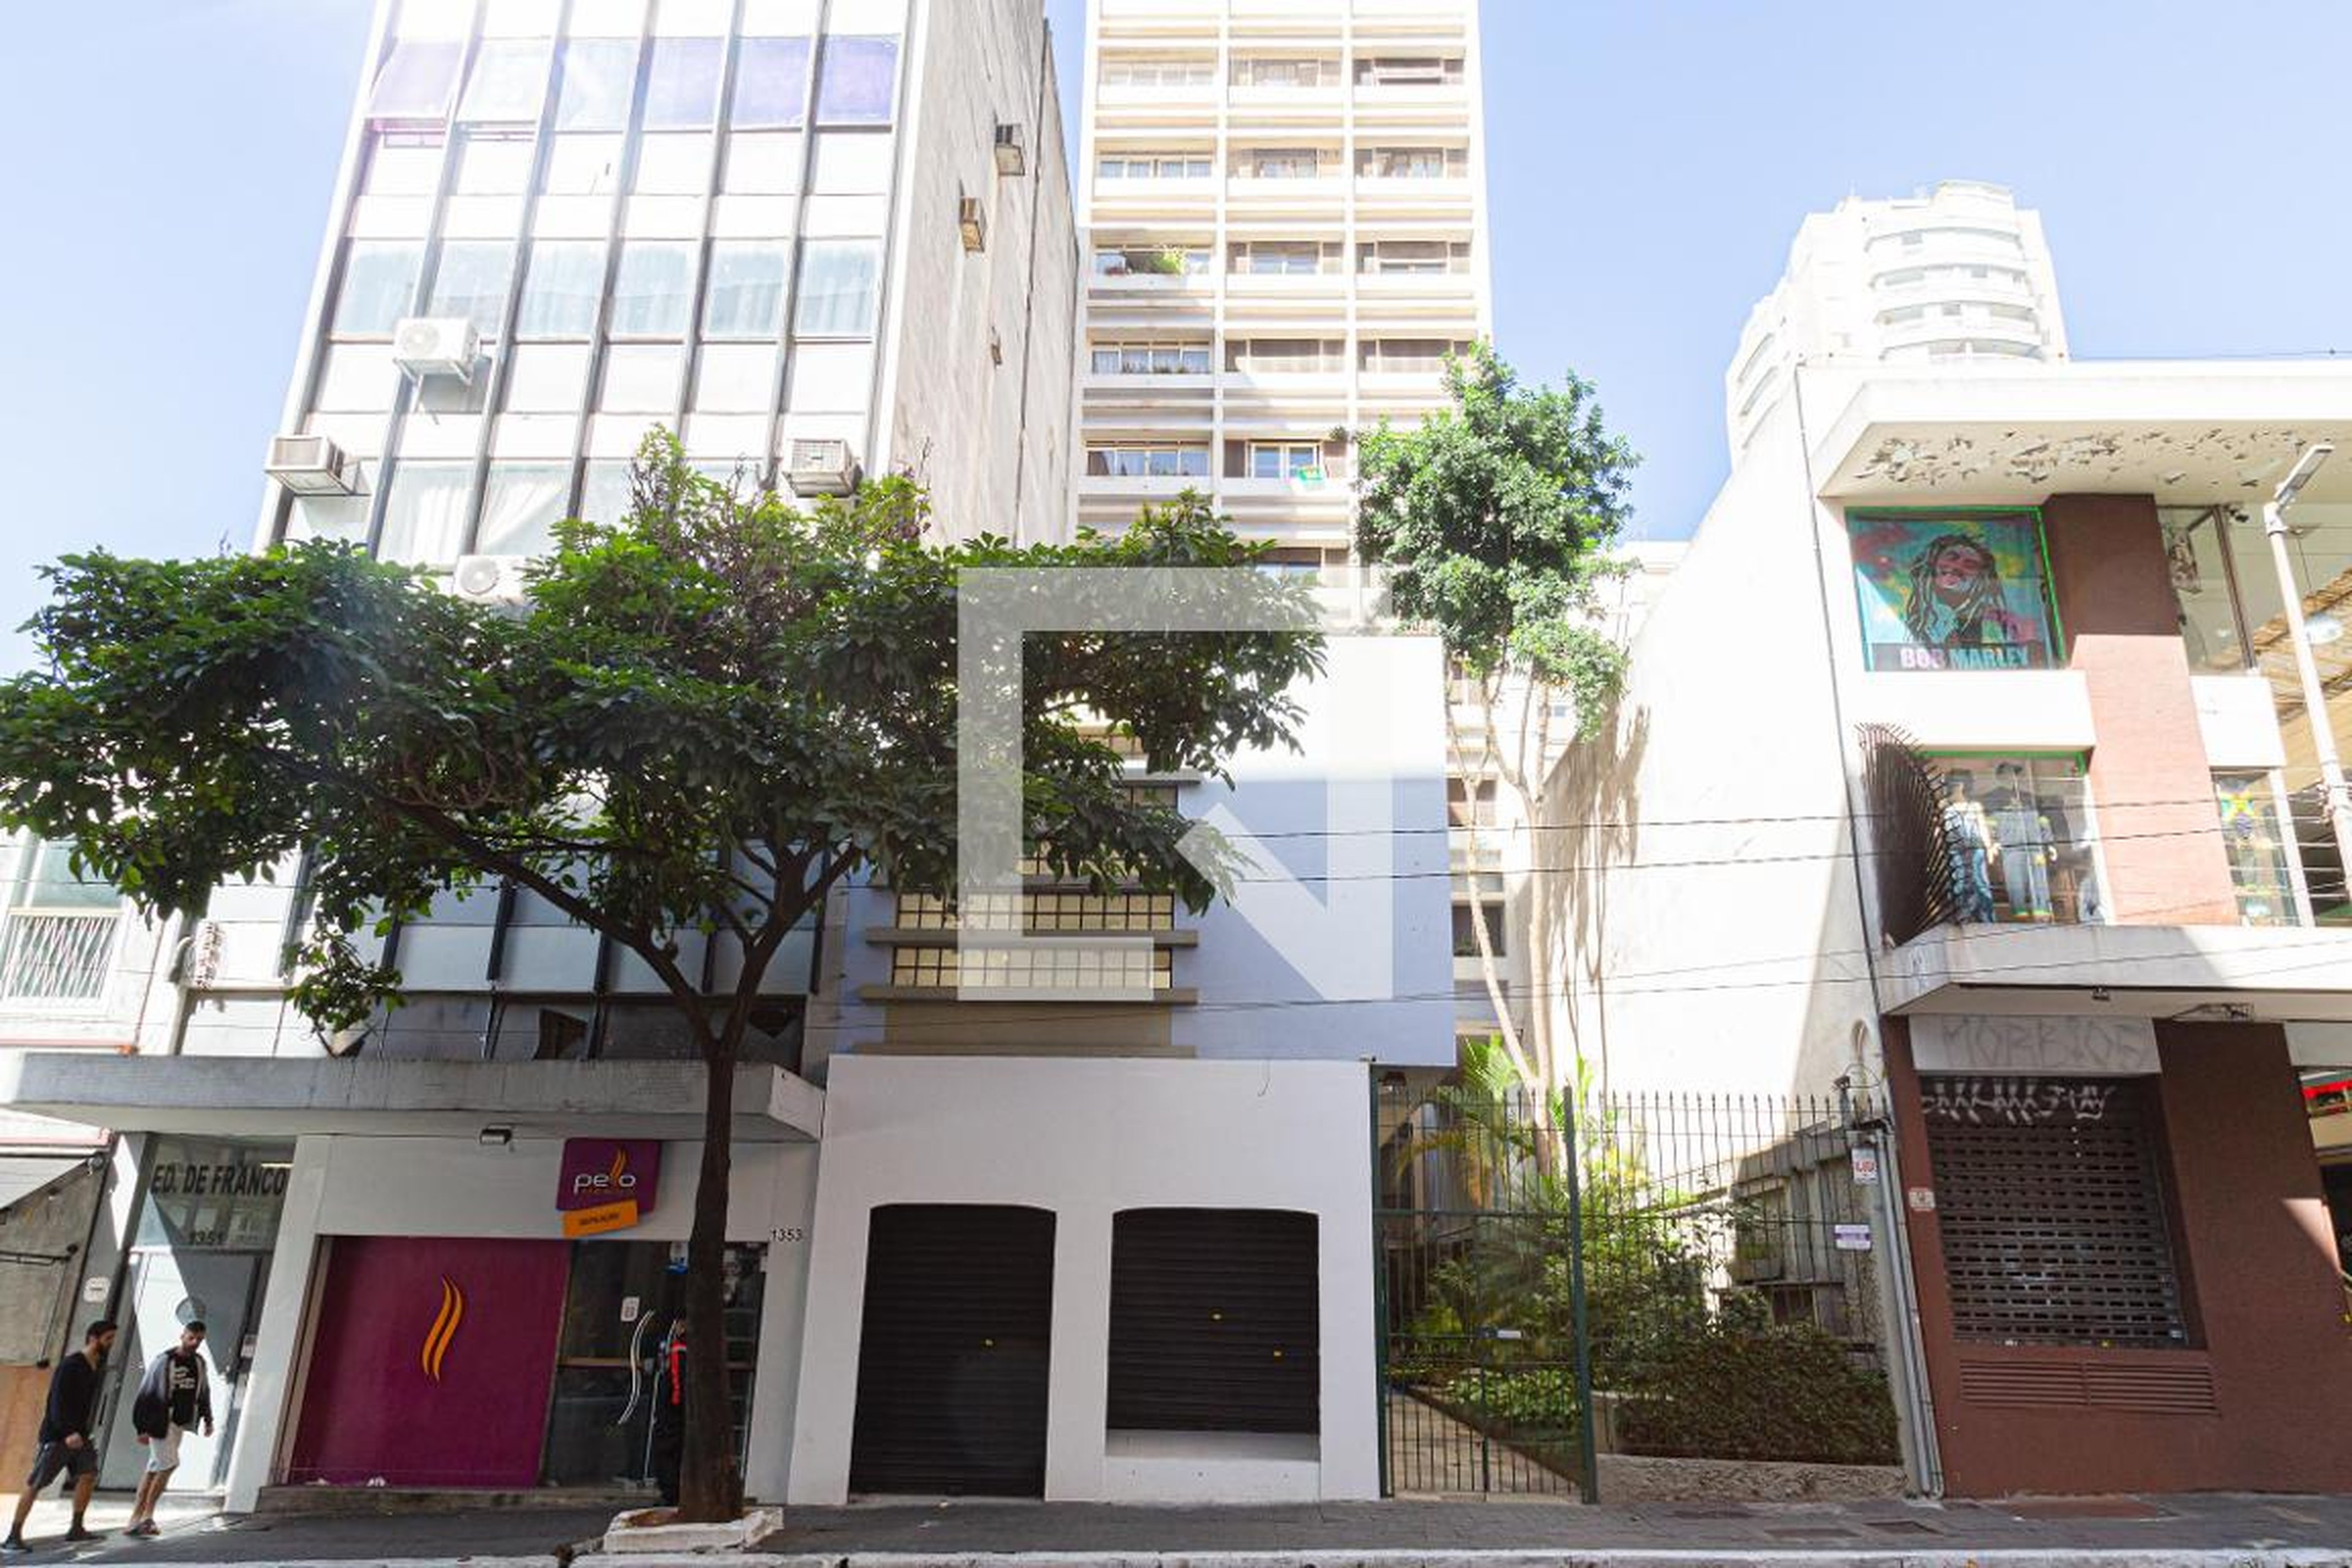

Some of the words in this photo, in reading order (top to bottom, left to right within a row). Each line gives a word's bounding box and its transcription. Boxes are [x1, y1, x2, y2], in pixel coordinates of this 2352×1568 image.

[151, 1164, 176, 1194] ED.
[183, 1165, 209, 1193] DE
[211, 1164, 288, 1194] FRANCO
[770, 1228, 803, 1242] 1353
